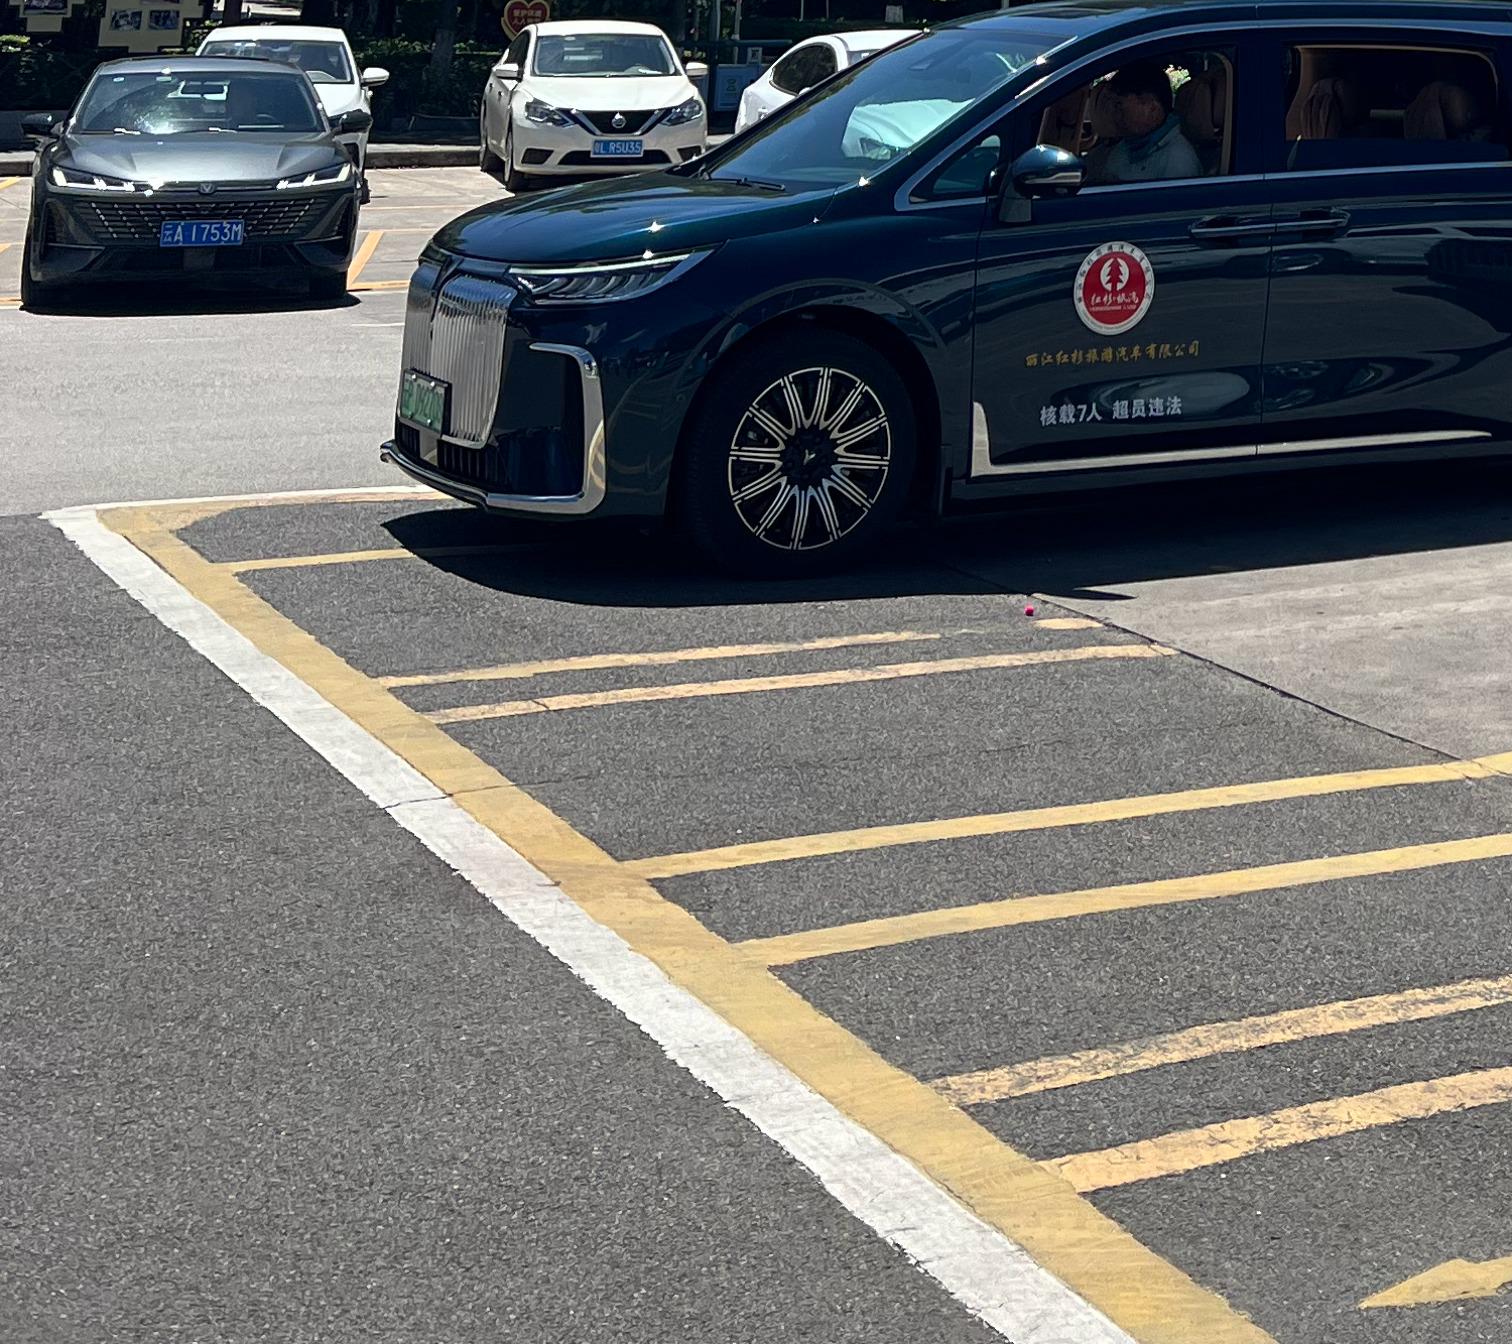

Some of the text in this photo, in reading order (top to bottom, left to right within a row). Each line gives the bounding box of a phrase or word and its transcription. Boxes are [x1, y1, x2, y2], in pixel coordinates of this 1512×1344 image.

[1040, 395, 1182, 427] 核载7人 超员违法
